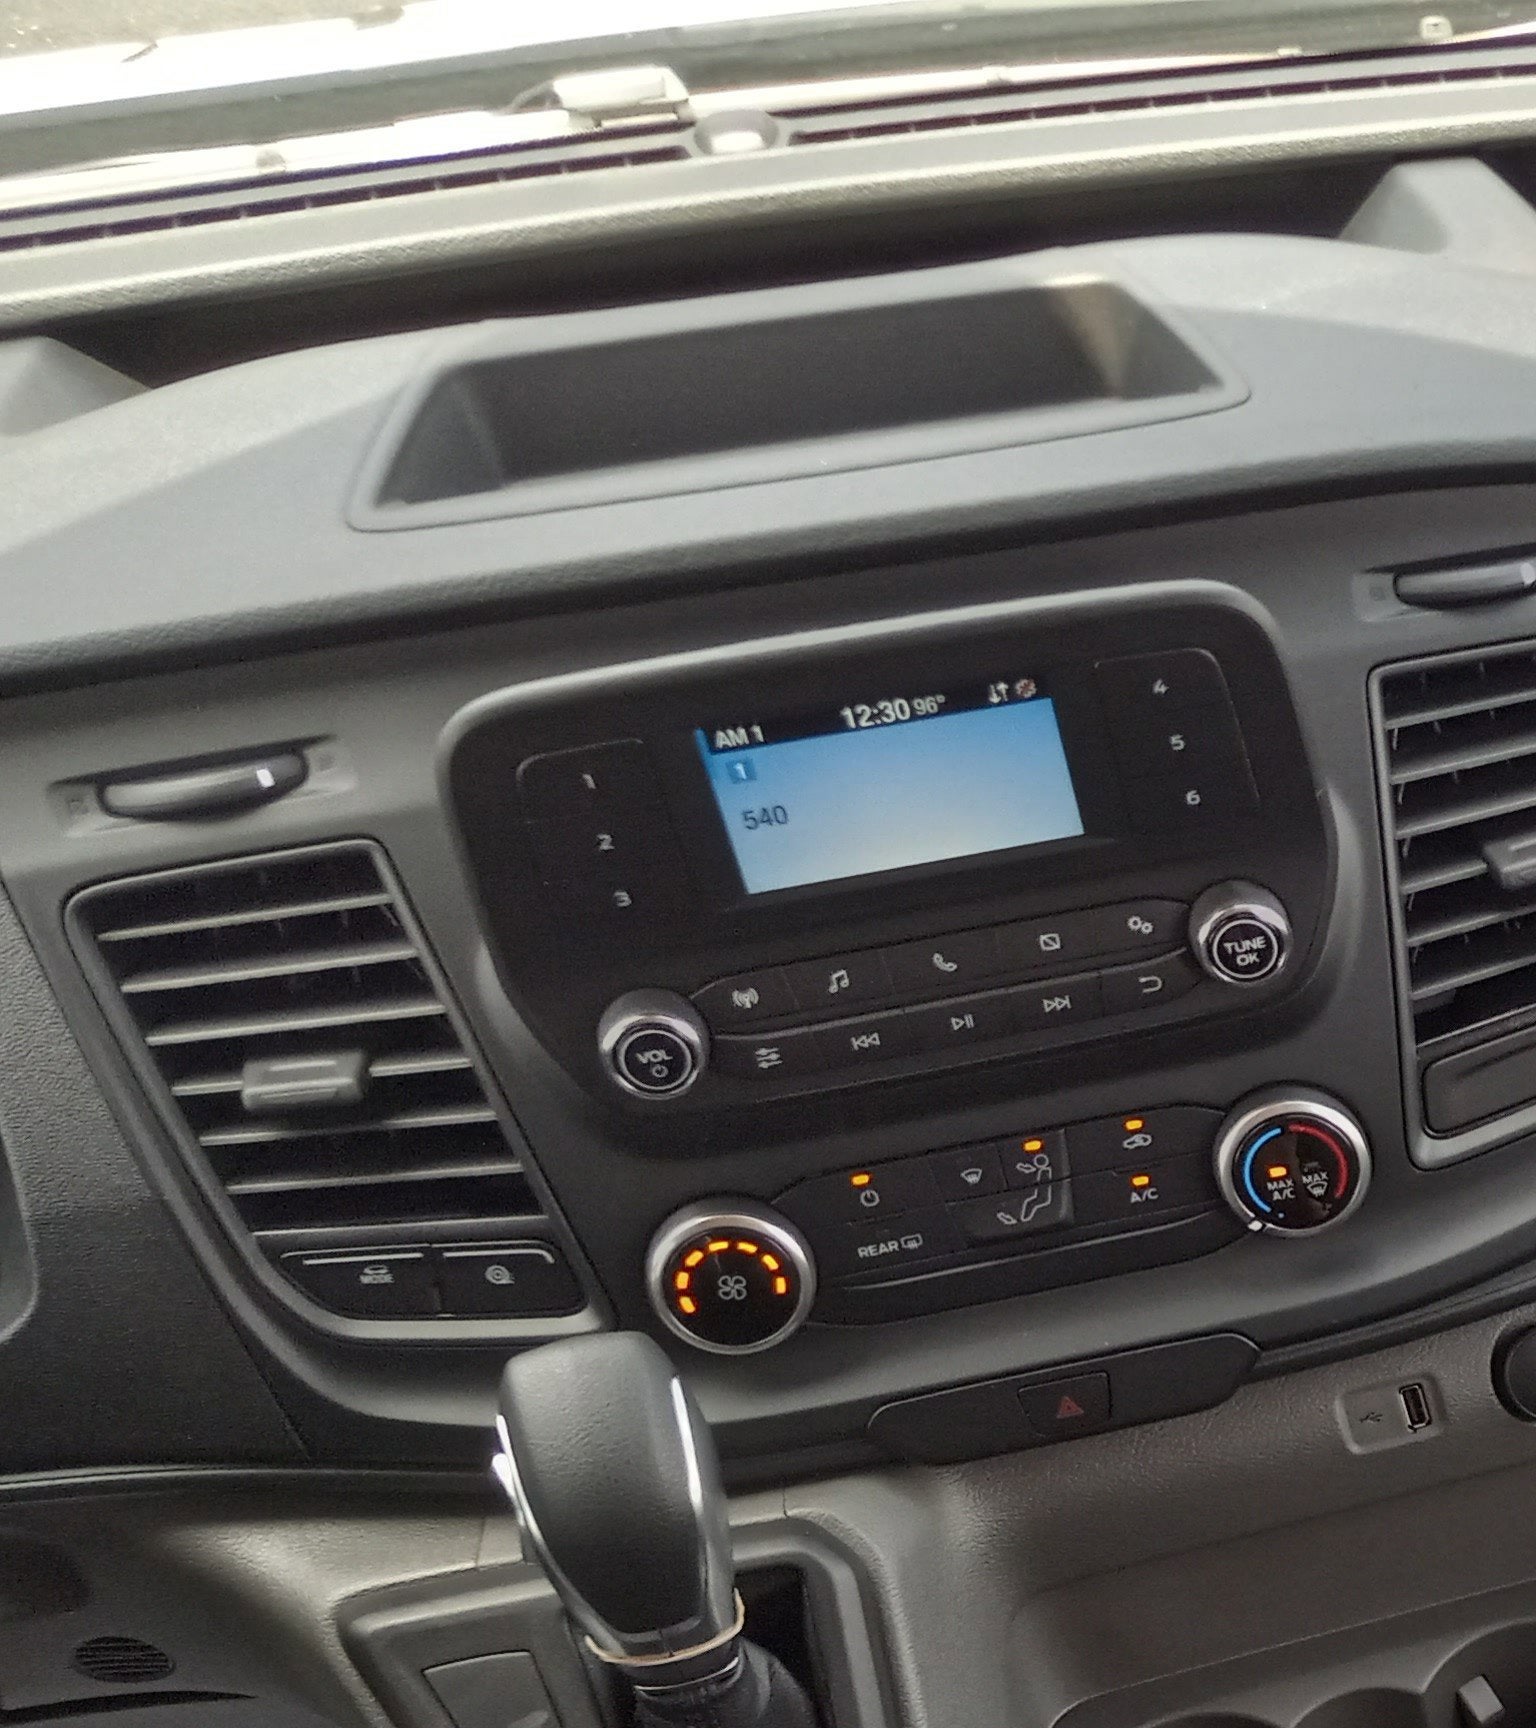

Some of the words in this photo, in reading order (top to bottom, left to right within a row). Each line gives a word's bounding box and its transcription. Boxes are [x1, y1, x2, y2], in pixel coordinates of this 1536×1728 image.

[1152, 678, 1169, 694] 4
[714, 727, 751, 750] AM
[751, 725, 764, 743] 1
[839, 698, 911, 729] 12:30
[1170, 733, 1185, 751] 5
[581, 772, 597, 790] 1
[1185, 790, 1201, 806] 6
[742, 804, 789, 830] 540
[596, 833, 615, 851] 2
[613, 889, 632, 908] 3
[1223, 935, 1267, 955] TUNE
[1236, 951, 1260, 967] OK
[636, 1049, 673, 1064] VOL
[1266, 1178, 1295, 1192] MAX
[1301, 1171, 1330, 1185] MAX
[1129, 1187, 1160, 1204] A/C
[1272, 1187, 1296, 1201] A/C
[857, 1240, 900, 1259] REAR
